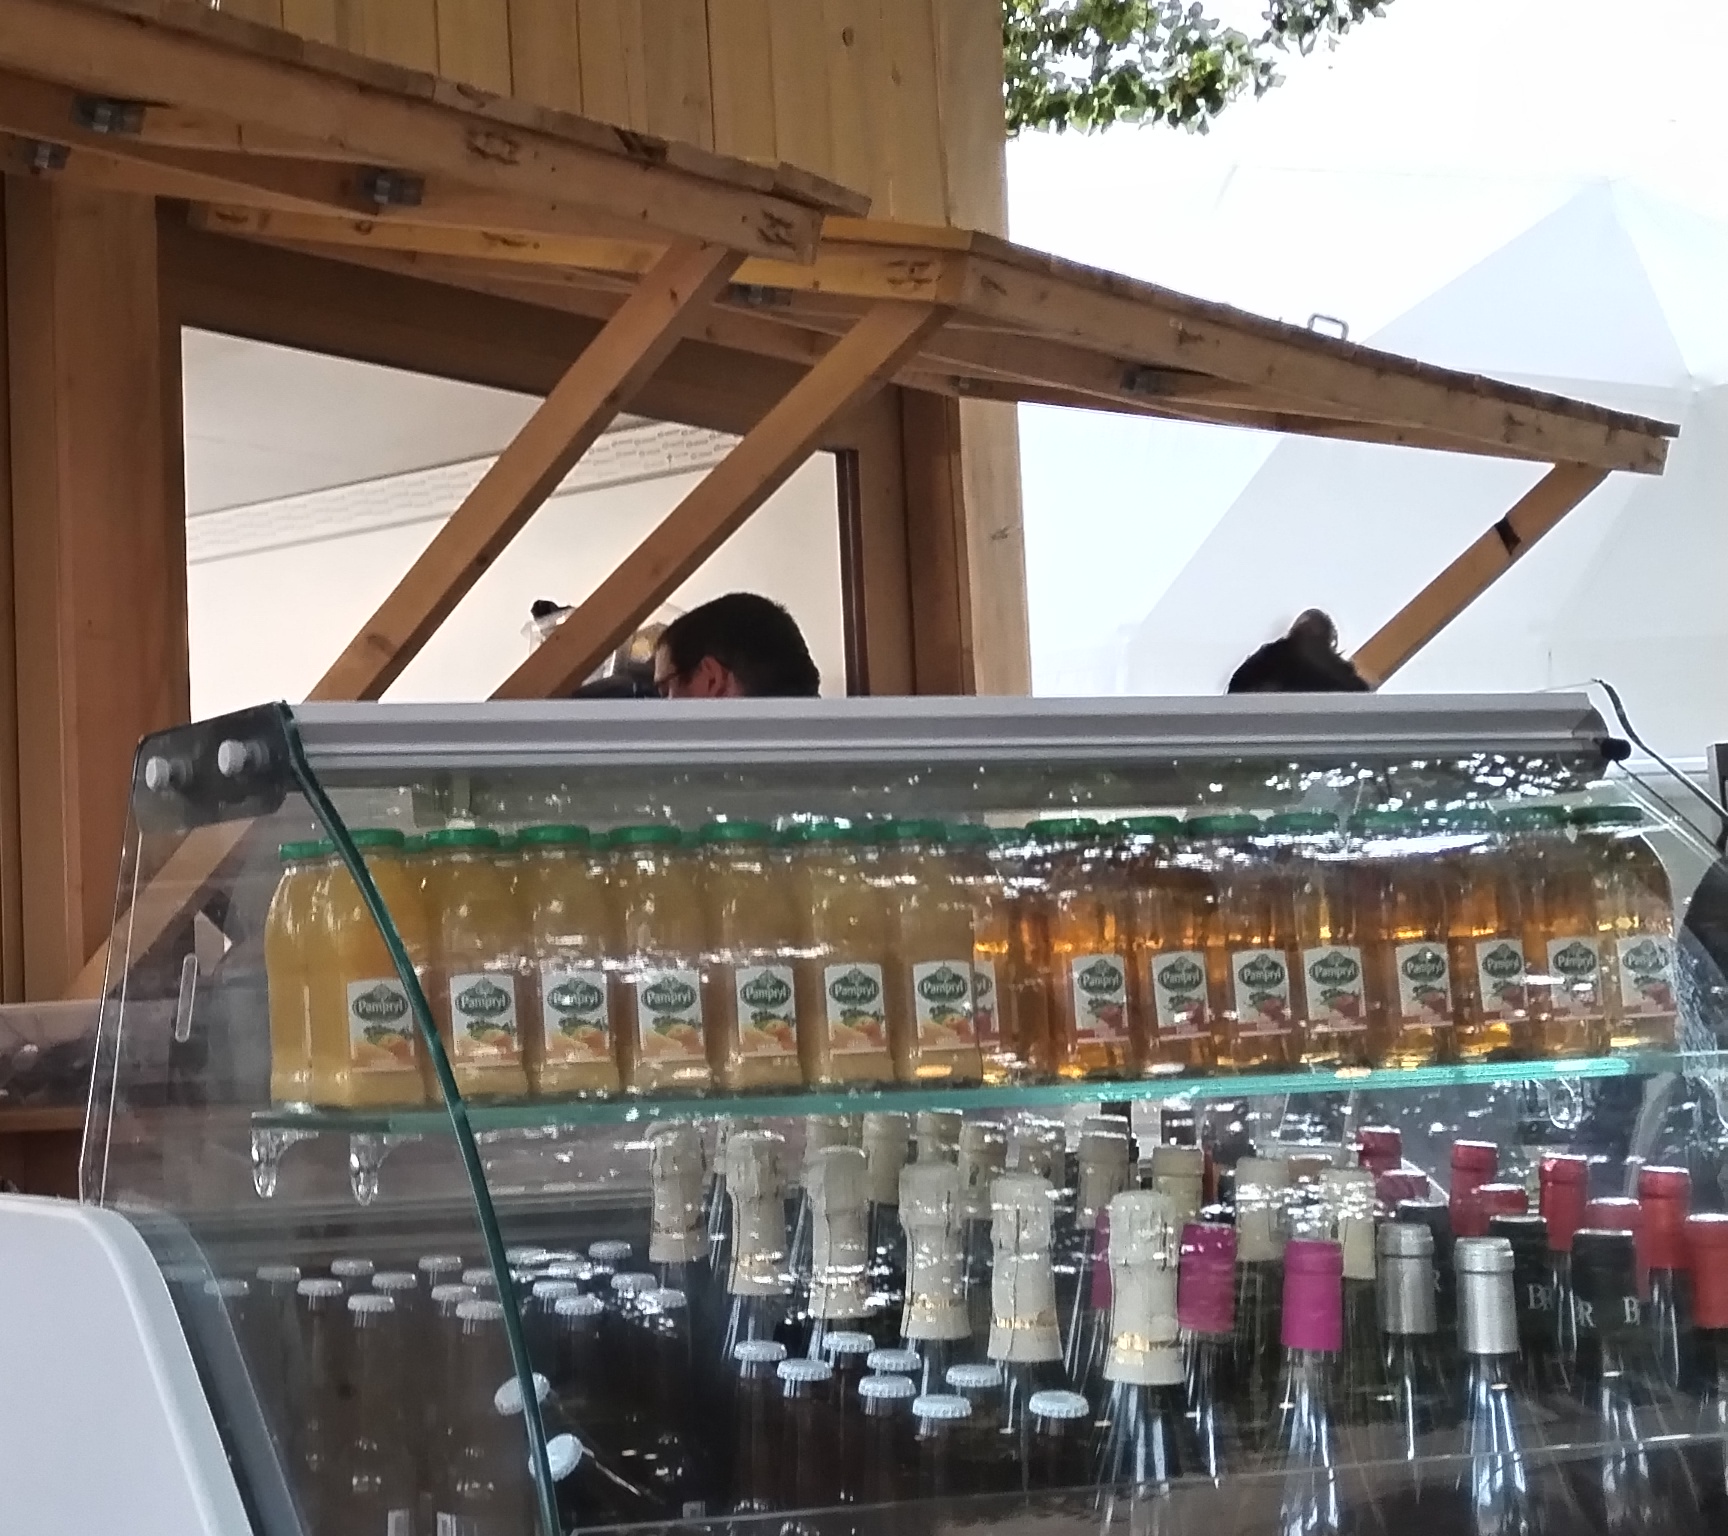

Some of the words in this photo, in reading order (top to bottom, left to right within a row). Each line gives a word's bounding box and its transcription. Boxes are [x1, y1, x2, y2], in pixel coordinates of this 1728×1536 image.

[1082, 972, 1119, 988] Pampryl
[1163, 970, 1200, 986] Pampryl
[1243, 966, 1281, 983] Pampryl
[1314, 964, 1355, 980] Pampryl
[746, 984, 787, 1001] Pampryl
[834, 982, 876, 1000] Pampryl
[923, 980, 965, 998] Pampryl
[357, 997, 404, 1014] Pampryl
[460, 994, 506, 1011] Pampryl
[647, 991, 692, 1008] Pampryl
